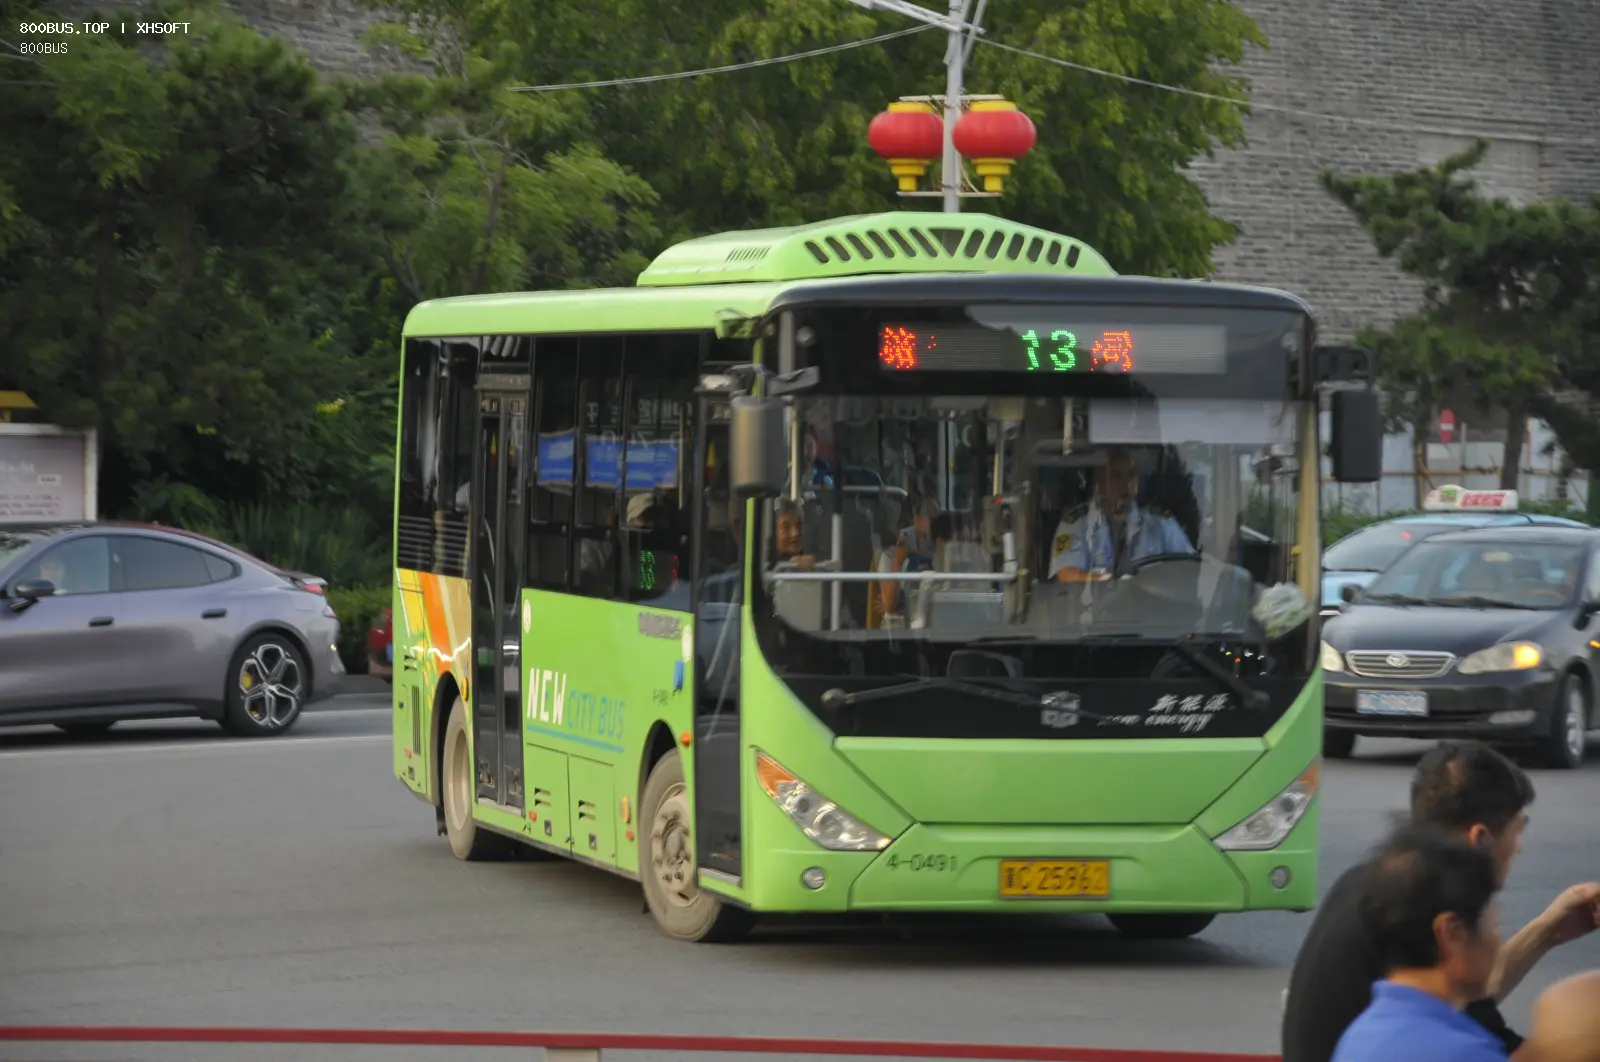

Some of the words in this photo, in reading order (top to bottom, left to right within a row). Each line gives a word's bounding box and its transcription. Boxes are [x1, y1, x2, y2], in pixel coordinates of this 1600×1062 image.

[1021, 329, 1077, 371] 13
[526, 667, 566, 726] NEW
[566, 689, 596, 735] CITY
[597, 696, 627, 741] BUS
[1148, 692, 1231, 713] 新能源
[1143, 713, 1215, 733] energy
